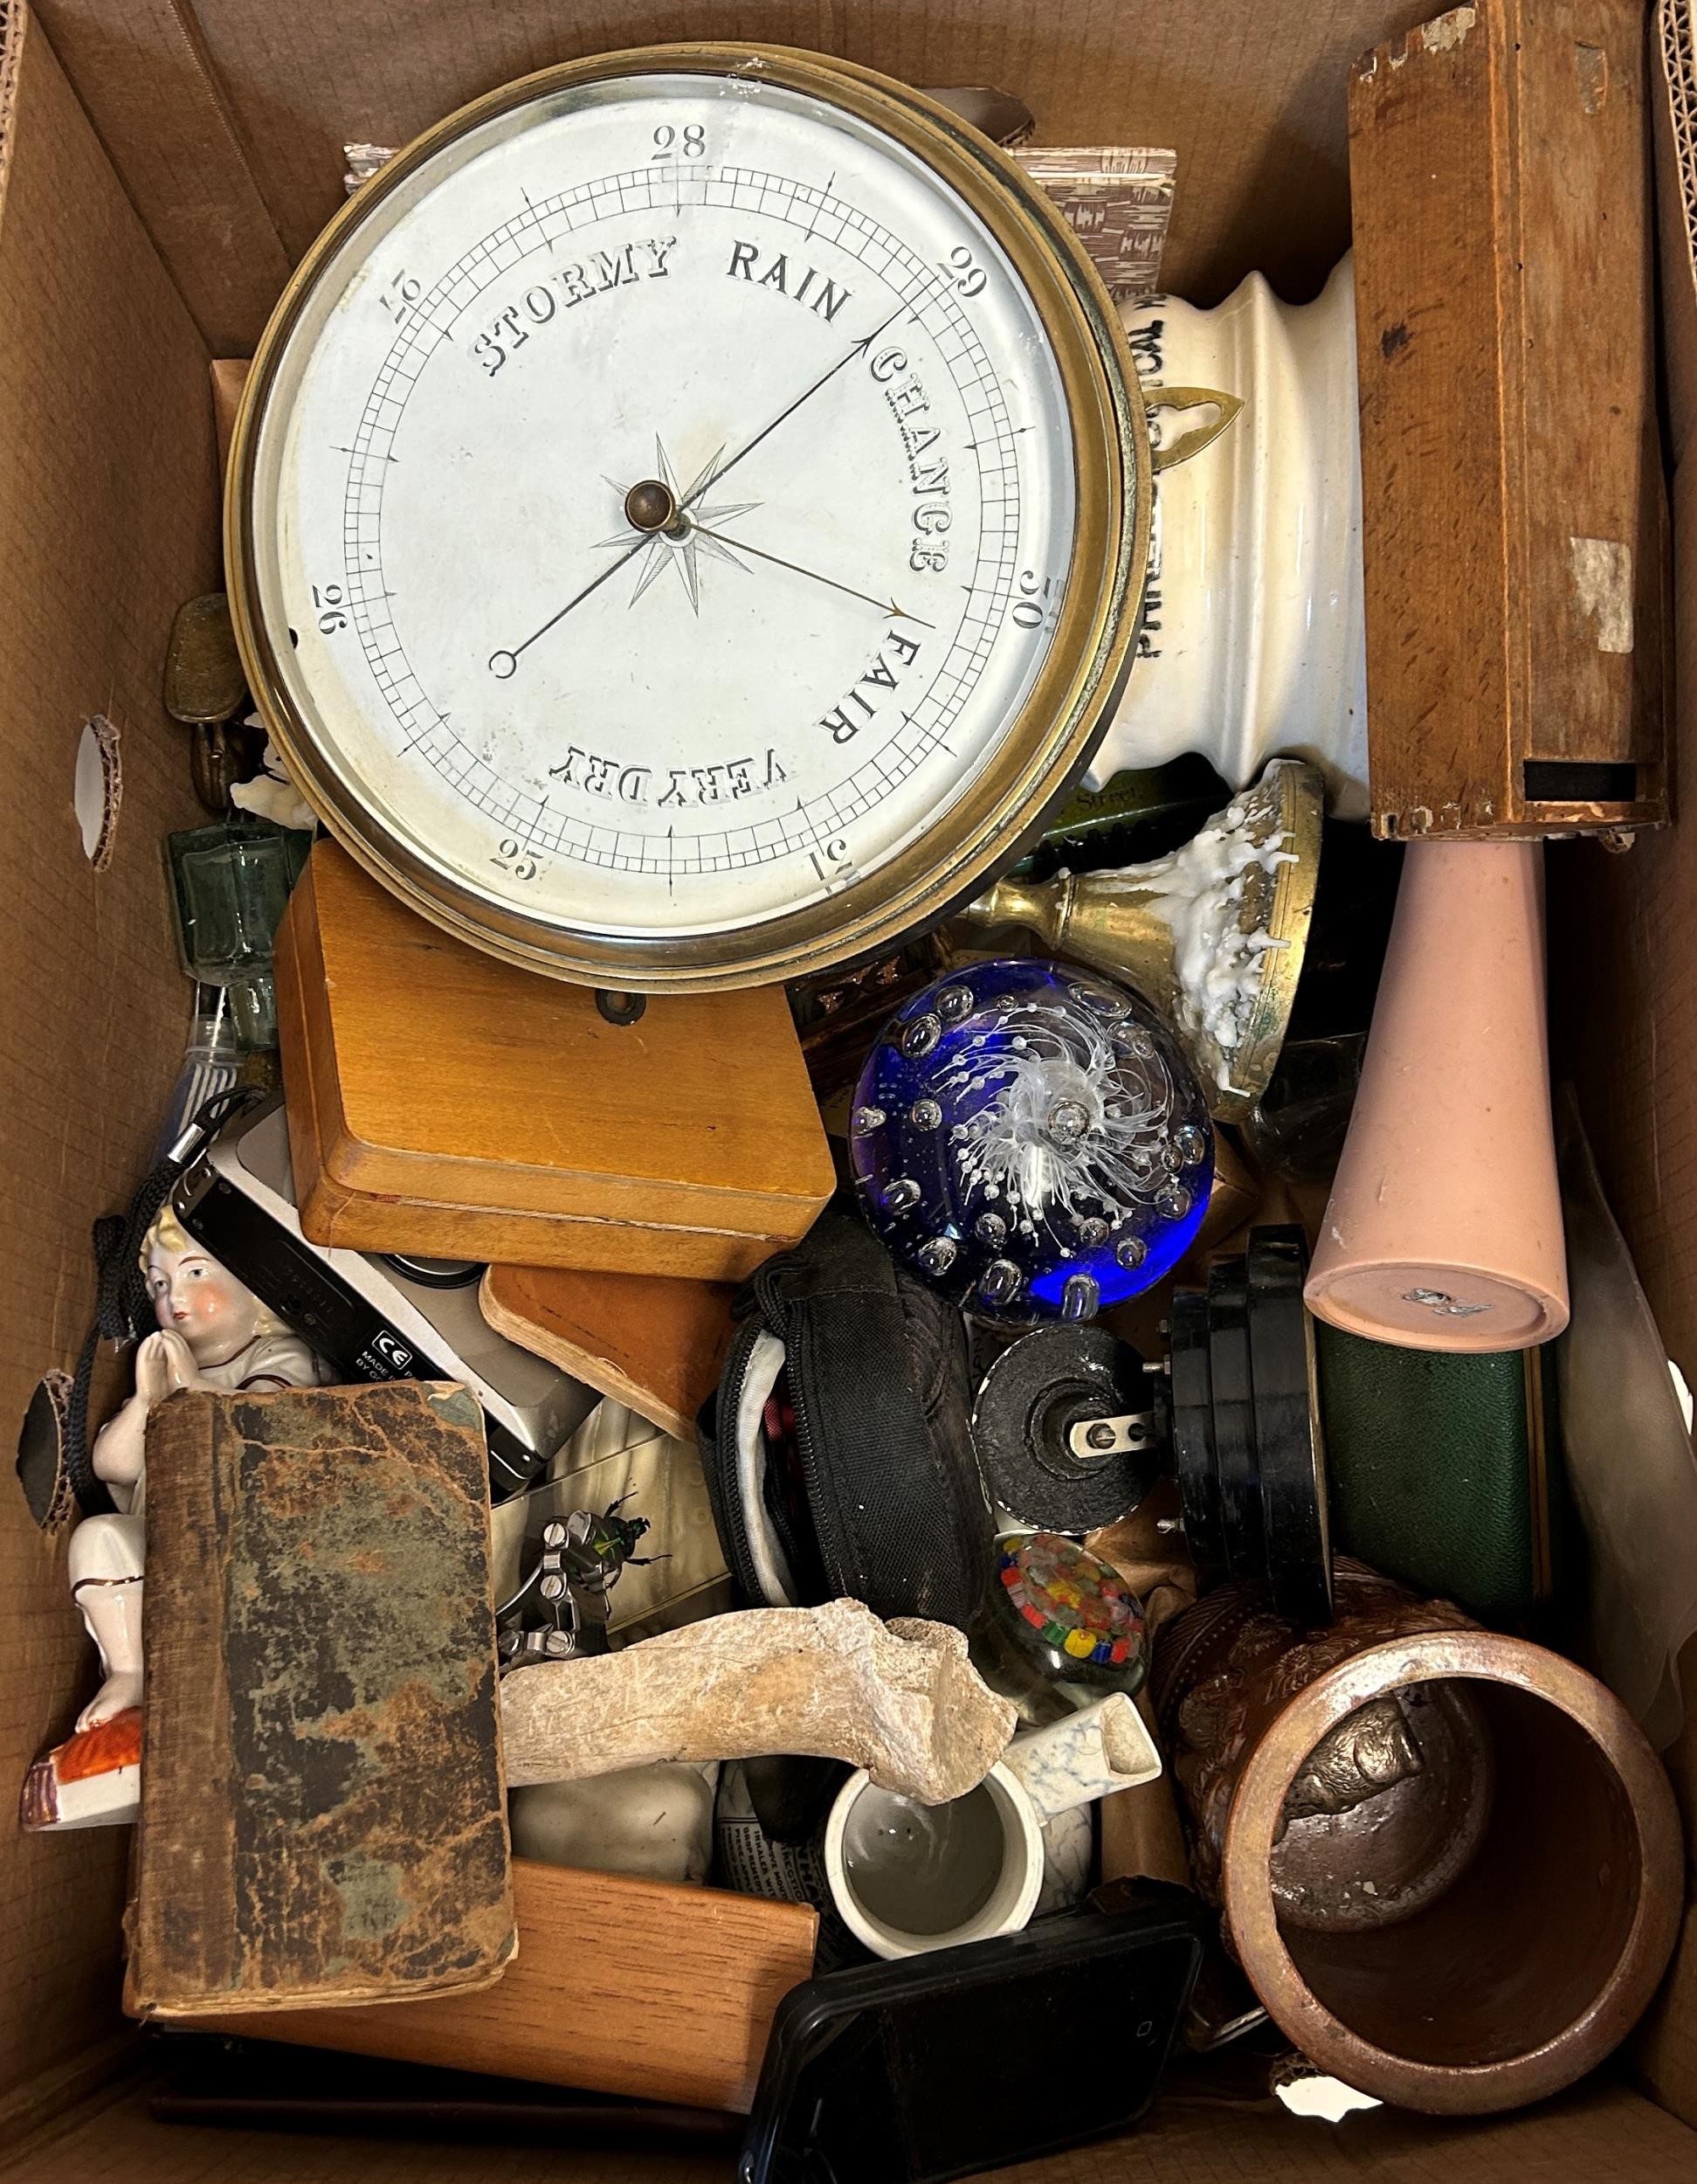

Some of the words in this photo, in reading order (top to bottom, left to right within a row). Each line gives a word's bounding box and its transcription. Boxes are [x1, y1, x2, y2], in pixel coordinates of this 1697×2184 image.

[651, 123, 707, 161] 28
[378, 267, 424, 325] 27
[726, 240, 854, 328] RAIN
[935, 245, 988, 300] 29
[466, 234, 678, 378] STORMY
[869, 344, 954, 575] CHANGE
[310, 583, 348, 637] 26
[1011, 568, 1062, 631] 30
[817, 629, 922, 746] FAIR
[548, 744, 653, 808] DRY
[657, 747, 791, 809] VERY
[488, 836, 546, 882] 25
[804, 838, 859, 891] 31
[355, 1358, 370, 1370] BY
[362, 1351, 390, 1377] MADE
[378, 1337, 409, 1366] CE
[748, 1854, 764, 1893] REMEDY
[754, 1830, 769, 1876] INHALER
